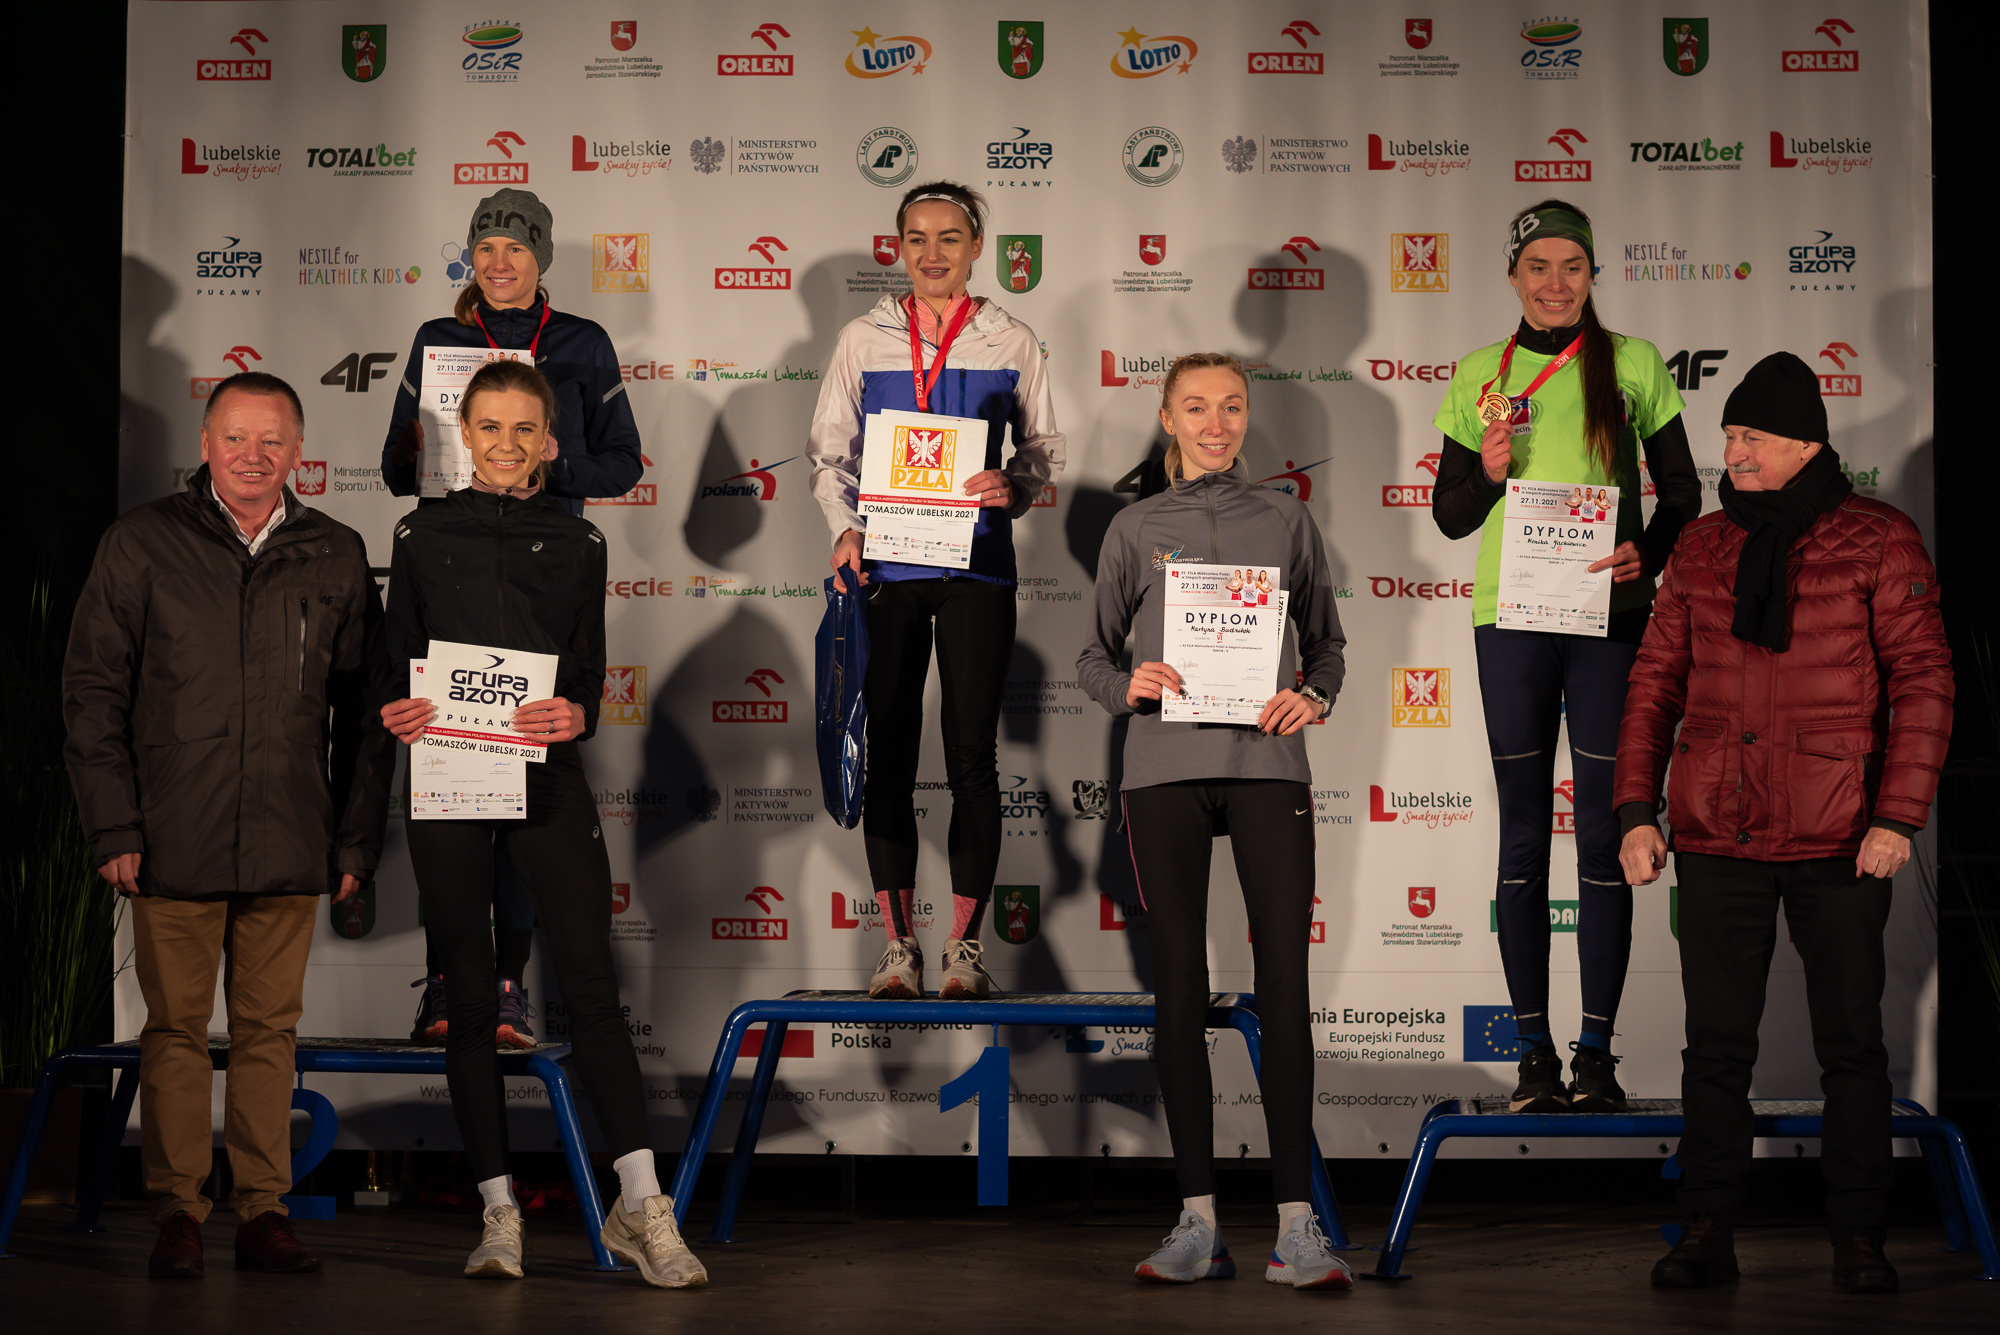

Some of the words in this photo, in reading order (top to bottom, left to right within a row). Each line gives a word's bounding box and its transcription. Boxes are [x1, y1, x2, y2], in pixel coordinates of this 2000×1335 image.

[862, 44, 915, 70] LOTTO
[1128, 44, 1181, 70] LOTTO
[1252, 55, 1320, 71] ORLEN
[1786, 54, 1854, 69] ORLEN
[200, 63, 267, 78] ORLEN
[721, 58, 789, 73] ORLEN
[738, 140, 817, 149] MINISTERSTWO
[860, 133, 875, 156] LASY
[873, 129, 916, 156] PAŃSTWOWE
[1125, 133, 1140, 155] LASY
[1139, 128, 1181, 155] PAŃSTWOWE
[1270, 139, 1348, 148] MINISTERSTWO
[738, 151, 794, 161] AKTYWÓW
[1270, 149, 1326, 160] AKTYWÓW
[213, 164, 250, 181] Smakuj
[458, 166, 524, 182] ORLEN
[604, 160, 641, 178] Smakuj
[738, 162, 819, 173] PAŃSTWOWYCH
[1270, 161, 1350, 173] PAŃSTWOWYCH
[1400, 159, 1438, 177] Smakuj
[1519, 164, 1587, 180] ORLEN
[1803, 157, 1840, 175] Smakuj
[345, 252, 360, 265] for
[1672, 248, 1687, 260] for
[299, 269, 369, 285] HEALTHIER
[374, 268, 401, 284] KIDS
[719, 271, 787, 287] ORLEN
[1252, 272, 1320, 287] ORLEN
[1624, 264, 1697, 282] HEALTHIER
[1703, 263, 1731, 280] KIDS
[595, 273, 645, 289] PZLA
[1395, 273, 1446, 289] PZLA
[320, 352, 398, 393] 4F
[711, 367, 767, 381] Tomaszów
[775, 369, 819, 382] Lubelski
[1247, 369, 1302, 382] Tomaszów
[1309, 367, 1353, 382] Lubelski
[915, 371, 923, 398] PZLA
[1820, 377, 1857, 394] LEN
[334, 467, 383, 477] Ministerst
[894, 469, 949, 489] PZLA
[334, 481, 367, 493] Sportu
[701, 484, 760, 500] polanik
[864, 504, 915, 515] TOMASZÓW
[917, 508, 953, 517] LUBELSKI
[955, 510, 974, 518] 2021
[1524, 525, 1594, 540] DYPLOM
[710, 584, 766, 598] Tomaszów
[773, 586, 818, 598] Lubelski
[1036, 591, 1082, 602] Turystyki
[1186, 612, 1257, 625] DYPLOM
[716, 704, 784, 720] ORLEN
[1396, 708, 1446, 724] PZLA
[447, 714, 511, 728] PUŁAW
[423, 737, 477, 751] TOMASZÓW
[479, 743, 518, 756] LUBELSKI
[520, 749, 540, 759] 2021
[734, 788, 812, 798] MINISTERSTWO
[734, 799, 789, 810] AKTYWÓW
[734, 811, 814, 822] PAŃSTWOWYCH
[1402, 811, 1440, 829] Smakuj
[716, 922, 783, 938] ORLEN
[1311, 1007, 1337, 1024] nia
[1344, 1008, 1446, 1028] Europejska
[832, 1033, 892, 1048] Polska
[1330, 1032, 1393, 1045] Europejski
[1396, 1031, 1446, 1043] Fundusz
[1316, 1049, 1358, 1061] ozwoju
[1362, 1048, 1446, 1062] Regionalnego
[819, 1088, 885, 1101] Funduszu
[1079, 1091, 1139, 1103] ramach
[1318, 1091, 1418, 1108] Gospodarczy
[940, 1047, 1009, 1206] 1
